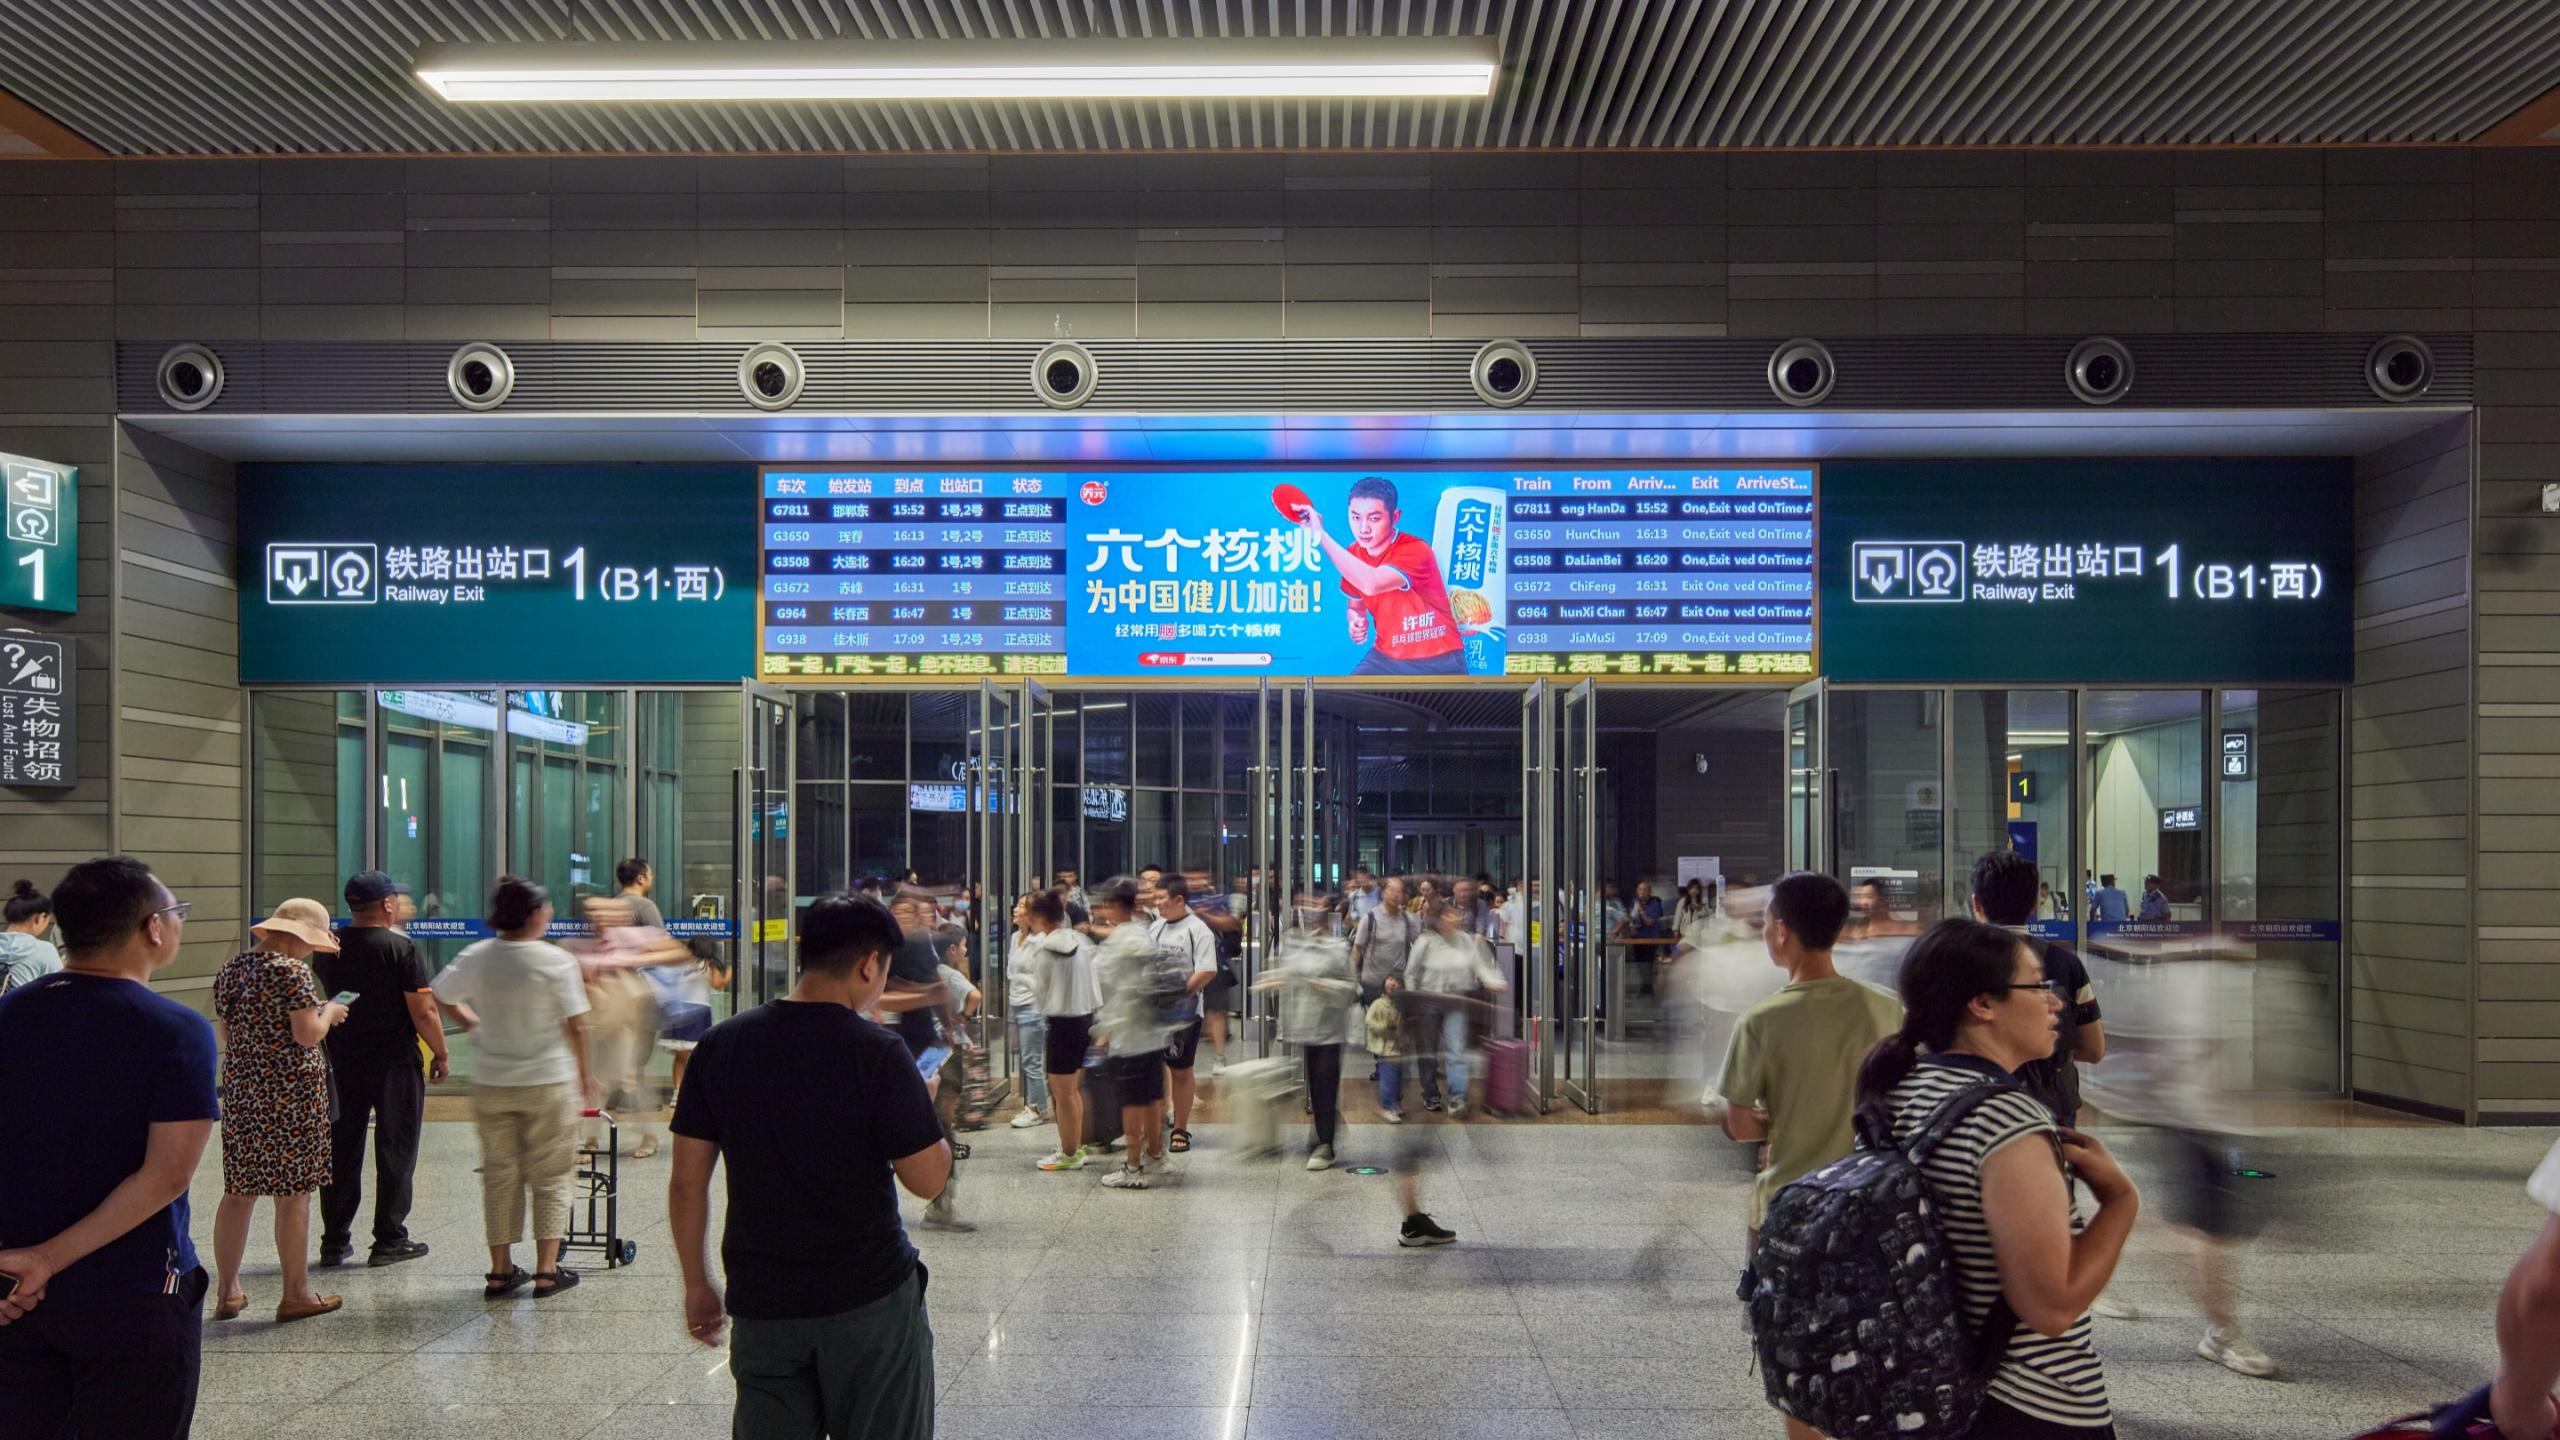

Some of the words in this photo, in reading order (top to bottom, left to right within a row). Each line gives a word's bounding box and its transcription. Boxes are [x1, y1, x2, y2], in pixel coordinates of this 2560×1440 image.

[777, 478, 806, 494] 车次
[828, 478, 872, 494] 始发站
[895, 478, 924, 494] 到点
[940, 478, 983, 494] 出站口
[1013, 478, 1042, 494] 状态
[1514, 477, 1551, 490] Train
[1573, 477, 1611, 490] From
[1628, 477, 1676, 490] Arriv...
[1692, 477, 1719, 490] Exit
[1736, 477, 1807, 490] ArriveSt...
[773, 505, 809, 516] G7811
[833, 504, 869, 517] 邯郸东
[893, 505, 924, 515] 15:52
[941, 504, 983, 517] 1号,2号
[1004, 504, 1051, 517] 正点到达
[1514, 503, 1551, 514] G7811
[1636, 503, 1667, 513] 15:52
[1683, 503, 1730, 515] One,Exit
[1735, 503, 1755, 513] ved
[1758, 503, 1802, 513] OnTime
[773, 531, 809, 542] G3650
[893, 531, 924, 541] 16:13
[941, 530, 983, 543] 1号,2号
[1004, 530, 1051, 543] 正点到达
[1514, 529, 1551, 540] G3650
[1566, 529, 1619, 540] HunChun
[1636, 529, 1667, 540] 16:13
[1683, 529, 1730, 541] One,Exit
[1735, 529, 1755, 540] ved
[1758, 529, 1802, 540] OnTime
[1453, 506, 1486, 581] 六个核桃
[1086, 528, 1321, 573] 六个核桃
[773, 557, 809, 567] G3508
[833, 555, 869, 569] 大连北
[893, 557, 924, 567] 16:20
[941, 556, 983, 568] 1号,2号
[1004, 555, 1051, 569] 正点到达
[1514, 555, 1551, 566] G3508
[1565, 555, 1621, 566] DaLianBei
[1636, 555, 1667, 565] 16:20
[1683, 555, 1730, 567] One,Exit
[1735, 555, 1755, 565] ved
[1758, 555, 1802, 565] OnTime
[19, 549, 45, 601] 1
[385, 546, 550, 580] 铁路出站口
[563, 547, 584, 600] 1
[1973, 544, 2142, 578] 铁路出站口
[2156, 544, 2178, 598] 1
[773, 582, 809, 593] G3672
[839, 581, 863, 594] 赤峰
[893, 582, 924, 593] 16:31
[952, 581, 972, 594] 1号
[1004, 581, 1051, 594] 正点到达
[1514, 581, 1551, 592] G3672
[1570, 581, 1616, 593] ChiFeng
[1636, 581, 1667, 591] 16:31
[1682, 581, 1703, 591] Exit
[1706, 581, 1729, 591] One
[1735, 581, 1755, 591] ved
[1758, 581, 1802, 591] OnTime
[1973, 584, 2038, 602] Railway
[2043, 584, 2074, 599] Exit
[385, 585, 449, 604] Railway
[454, 585, 485, 601] Exit
[777, 608, 806, 619] G964
[833, 607, 869, 620] 长春西
[893, 608, 924, 618] 16:47
[952, 607, 972, 619] 1号
[1004, 607, 1051, 620] 正点到达
[1518, 607, 1547, 618] G964
[1560, 606, 1593, 618] hunXi
[1636, 607, 1667, 617] 16:47
[1682, 606, 1703, 617] Exit
[1706, 607, 1729, 617] One
[1735, 606, 1755, 617] ved
[1758, 606, 1802, 617] OnTime
[1403, 612, 1435, 632] 许昕
[1115, 623, 1281, 640] 经常用脑多喝六个核桃
[1392, 625, 1446, 647] 乒乓球世界冠军
[1518, 632, 1547, 643] G938
[1570, 632, 1615, 643] JiaMuSi
[1636, 632, 1667, 643] 17:09
[1683, 632, 1730, 644] One,Exit
[1735, 632, 1755, 643] ved
[1758, 632, 1802, 643] OnTime
[777, 634, 806, 645] G938
[833, 633, 869, 646] 佳木斯
[893, 634, 924, 644] 17:09
[941, 633, 983, 645] 1号,2号
[1004, 633, 1051, 646] 正点到达
[1160, 655, 1177, 664] 京东
[3, 696, 18, 718] Lost
[3, 723, 18, 745] And
[22, 697, 61, 780] 失物招领
[3, 749, 18, 780] Found
[2018, 778, 2028, 797] 1
[405, 922, 465, 930] 北京朝阳站欢迎您
[665, 922, 725, 930] 北京朝阳站欢迎您
[2118, 924, 2179, 932] 北京朝阳站欢迎您
[2250, 924, 2311, 932] 北京朝阳站欢迎您
